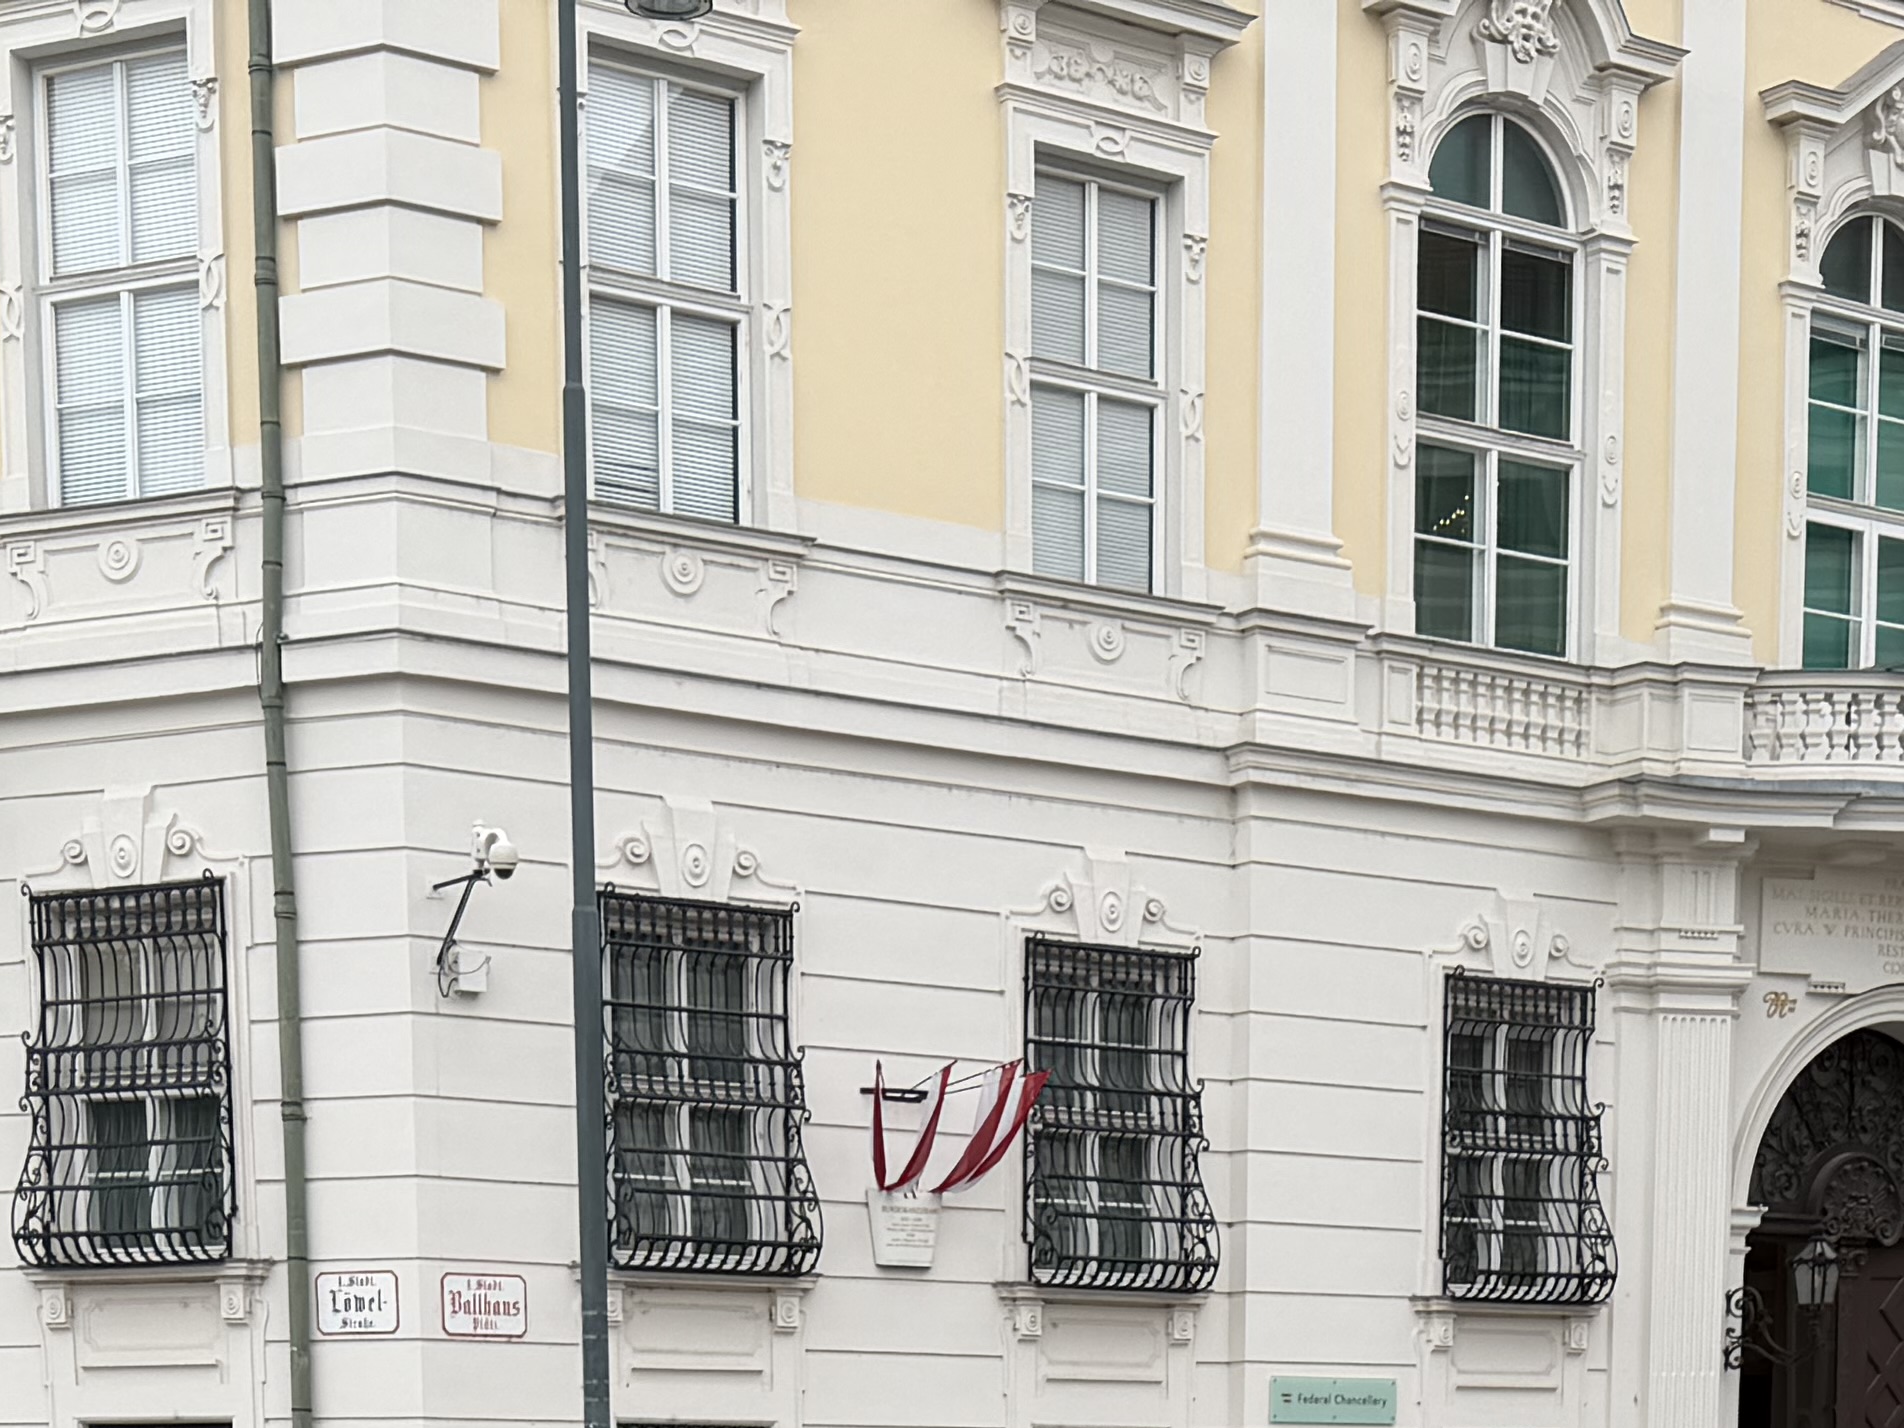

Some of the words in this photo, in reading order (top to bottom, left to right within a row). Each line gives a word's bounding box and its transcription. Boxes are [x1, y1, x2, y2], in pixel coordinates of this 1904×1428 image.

[329, 1288, 388, 1314] Löwel-
[448, 1290, 521, 1319] Ballhaus
[1297, 1392, 1332, 1405] Federal
[1334, 1393, 1387, 1409] Chancellery
